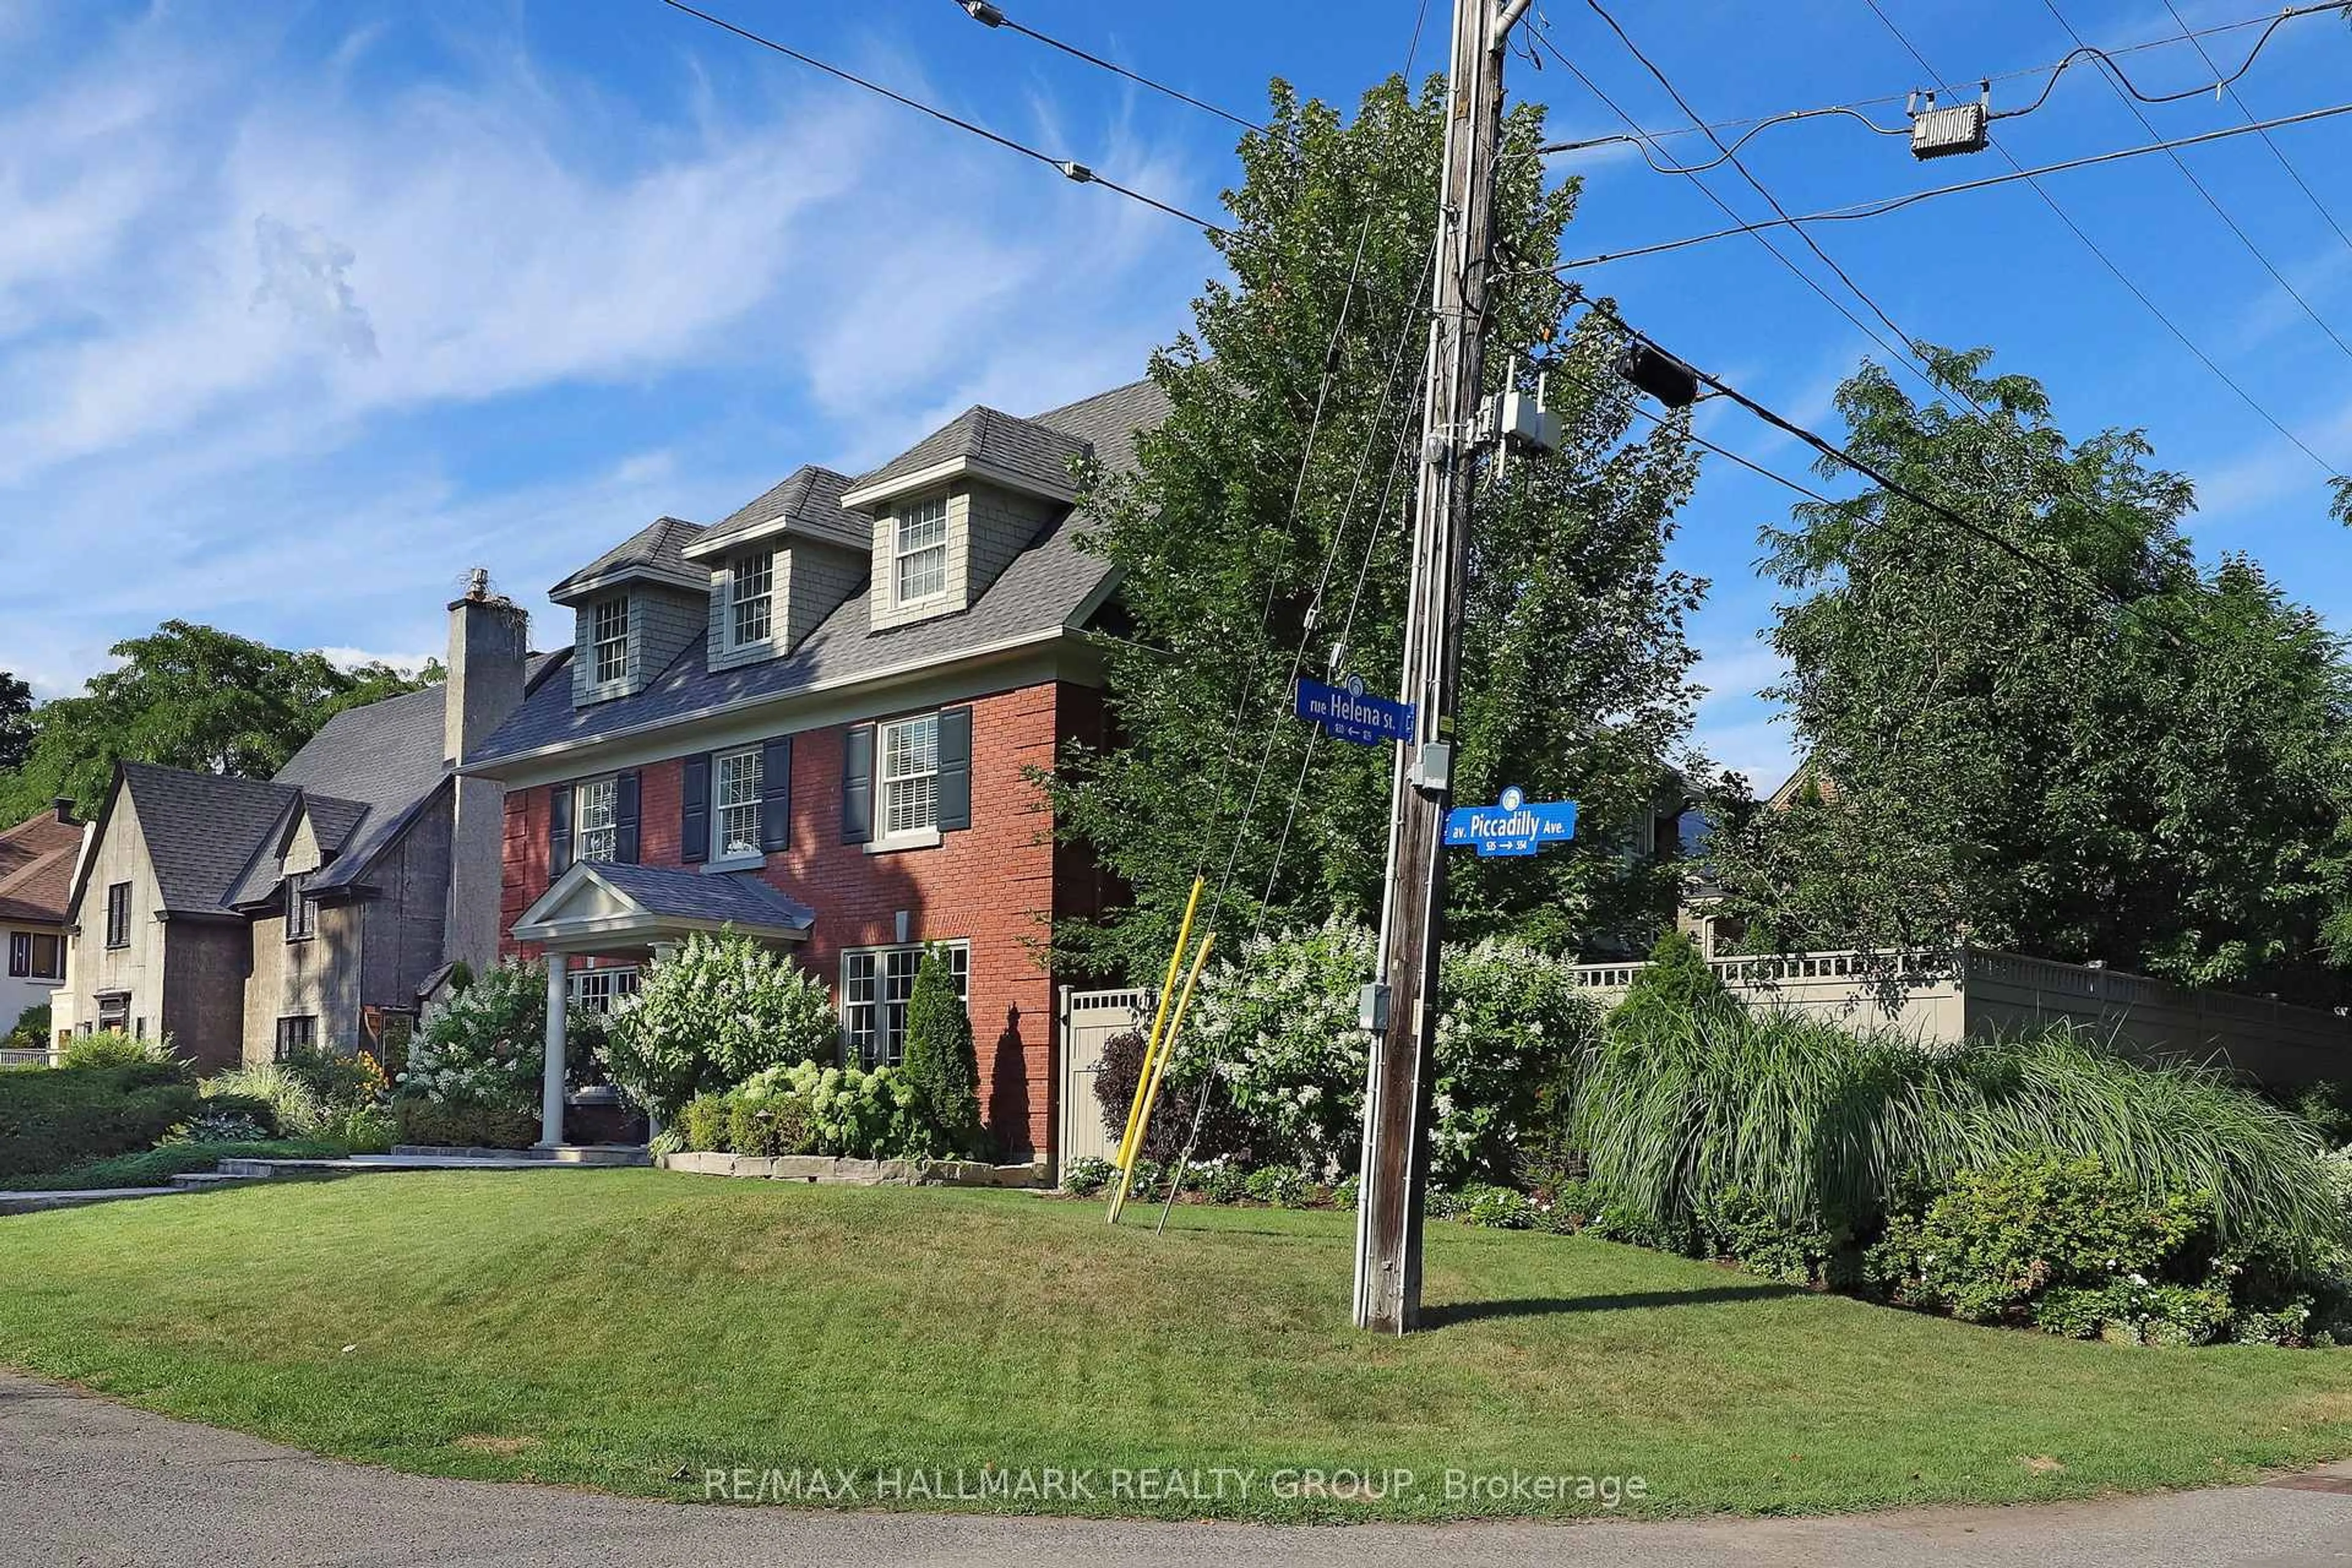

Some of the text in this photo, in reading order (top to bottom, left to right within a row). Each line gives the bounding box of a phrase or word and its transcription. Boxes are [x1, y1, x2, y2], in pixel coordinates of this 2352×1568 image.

[1310, 693, 1395, 730] rue Helena St.
[1453, 810, 1565, 841] av. Piccadilly Ave.
